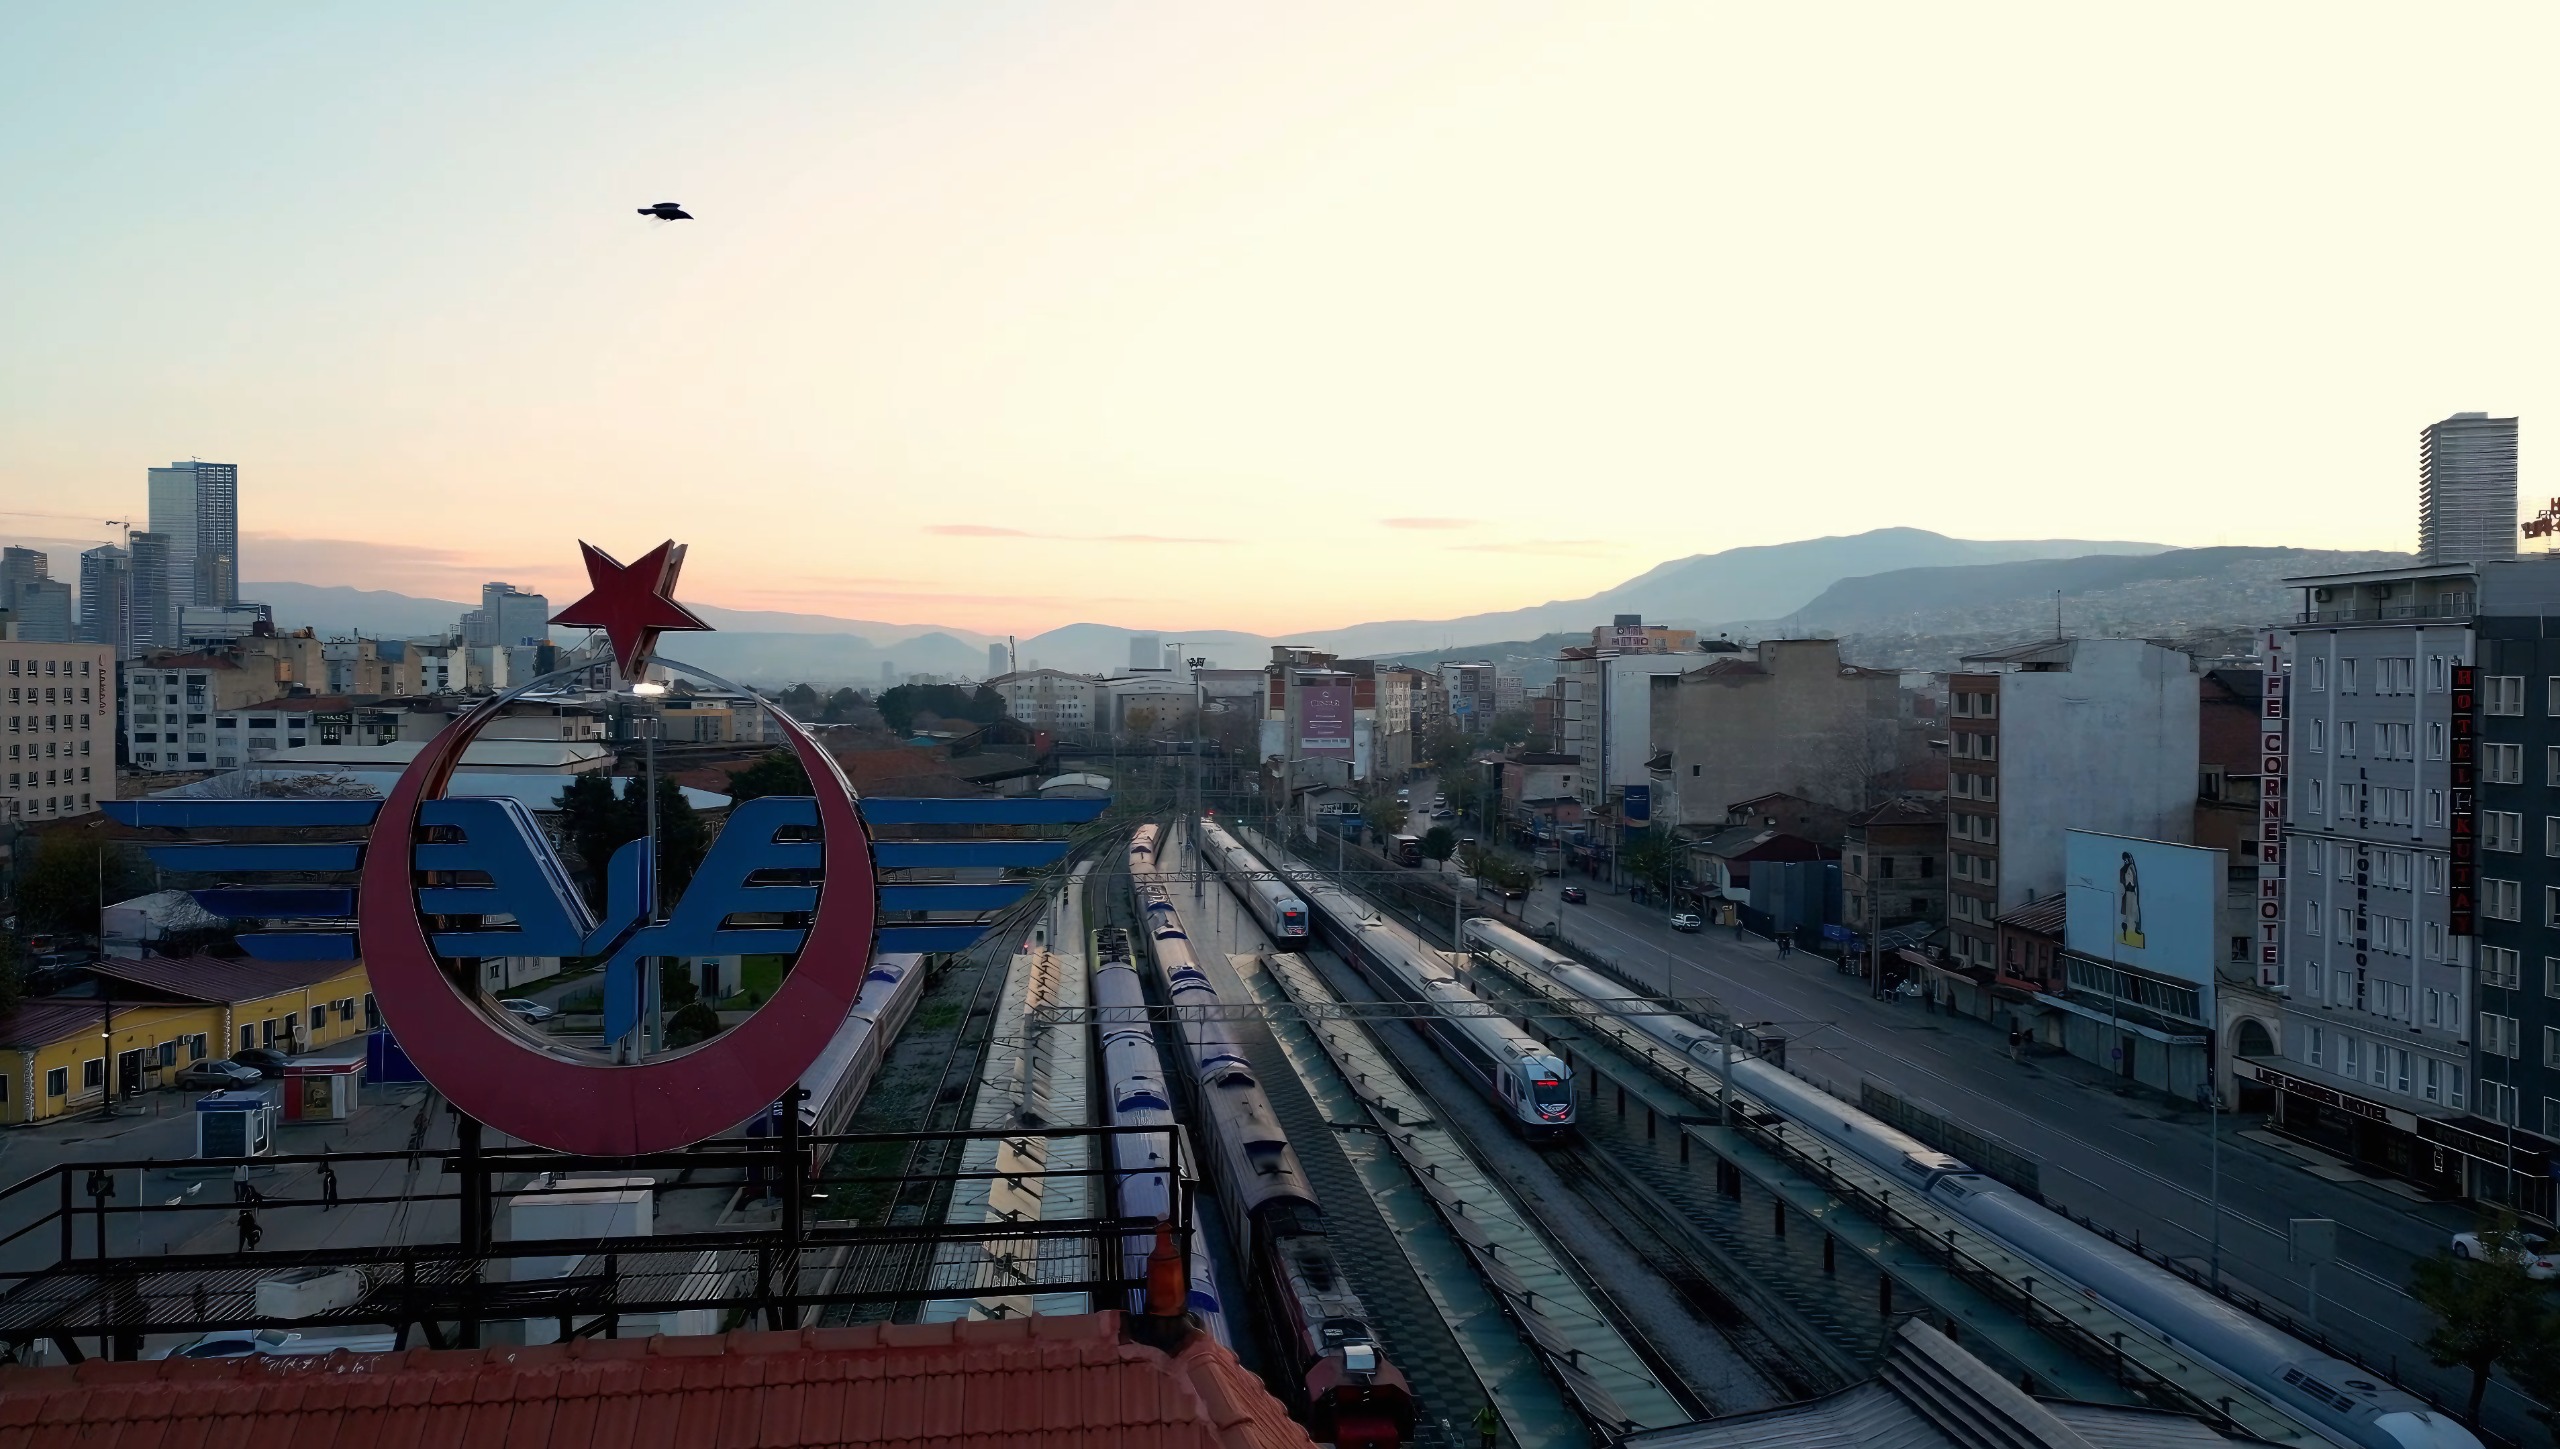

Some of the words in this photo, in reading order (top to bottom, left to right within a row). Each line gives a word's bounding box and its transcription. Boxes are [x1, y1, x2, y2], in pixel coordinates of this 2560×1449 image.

[2265, 633, 2281, 718] LIFE
[2456, 669, 2472, 783] HOTEL
[2263, 734, 2281, 863] CORNER
[2359, 767, 2369, 830] LIFE
[2356, 842, 2370, 931] CORNER
[2456, 817, 2472, 932] KUTAY
[2261, 879, 2279, 986] HOTEL
[2355, 937, 2369, 1011] HOTEL
